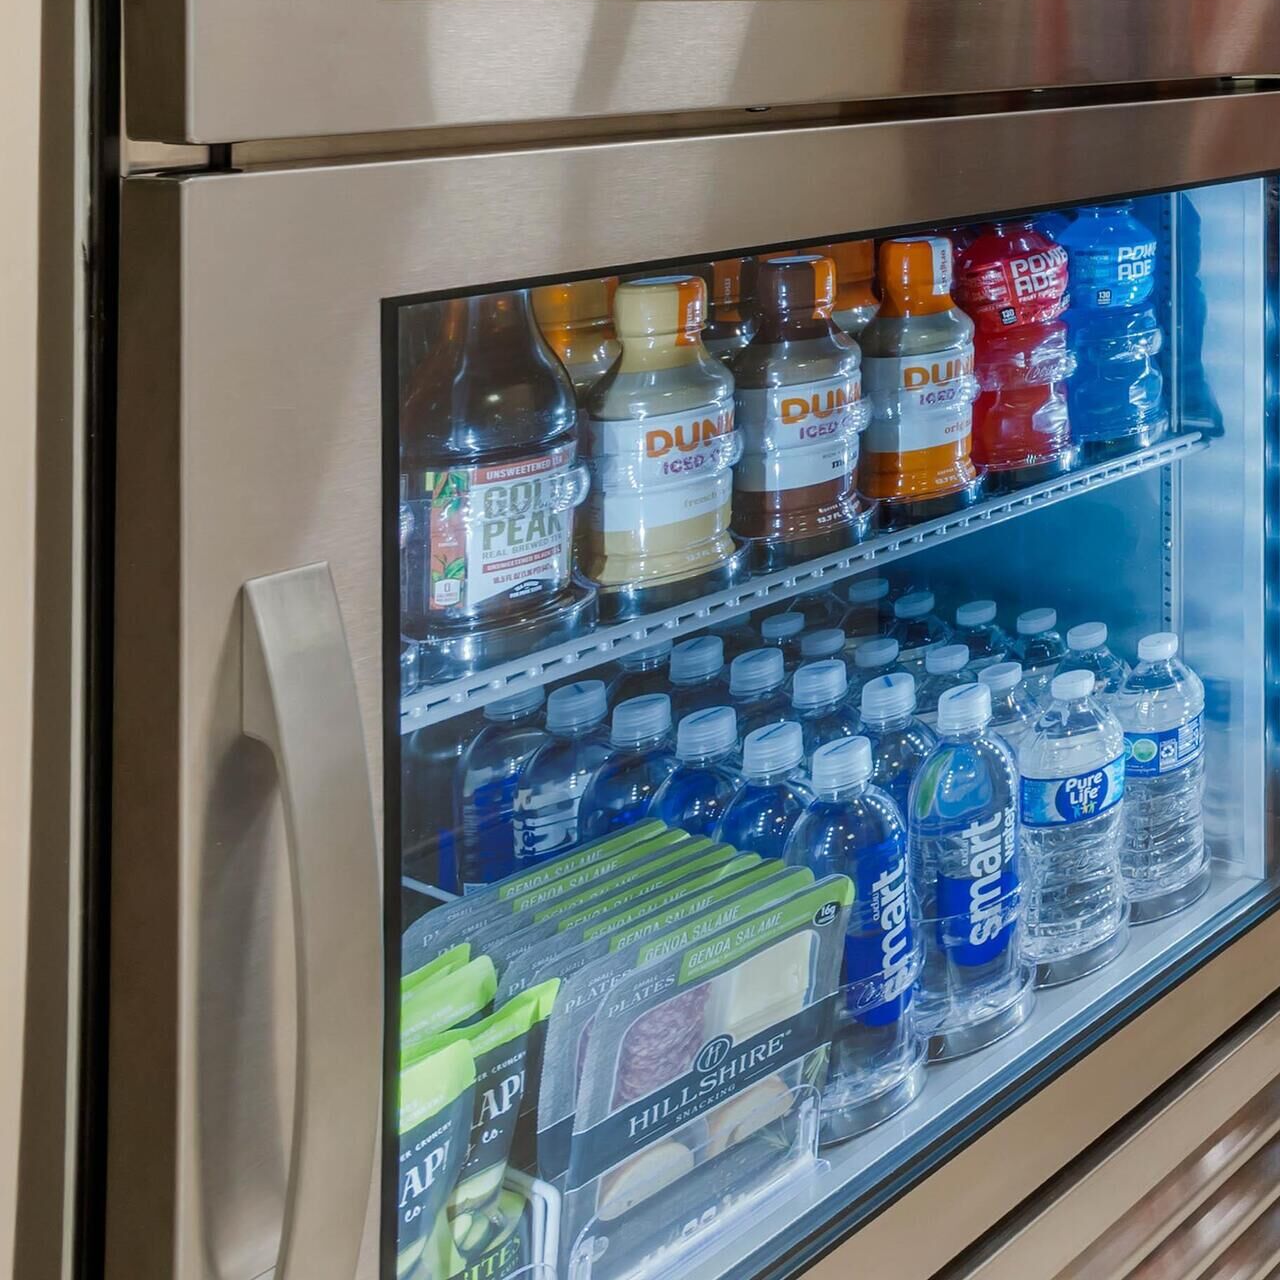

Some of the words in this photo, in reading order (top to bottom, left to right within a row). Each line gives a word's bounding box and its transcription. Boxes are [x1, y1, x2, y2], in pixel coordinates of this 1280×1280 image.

[1010, 245, 1068, 279] POWE
[1117, 240, 1157, 263] POW
[1013, 270, 1058, 297] ADE
[1117, 258, 1152, 281] ADE
[919, 388, 956, 406] ICED
[799, 422, 837, 440] ICED
[485, 458, 551, 481] UNSWEETENED
[663, 455, 705, 475] ICED
[482, 509, 563, 552] PEAK
[482, 549, 509, 561] REAL
[511, 538, 550, 554] BREWED
[1065, 770, 1103, 794] Pure
[1068, 785, 1099, 806] Life
[1002, 805, 1017, 863] water
[968, 811, 1003, 947] smart
[663, 894, 716, 925] SALAME
[820, 903, 838, 918] 16g
[643, 930, 689, 963] GENOA
[691, 905, 741, 938] SALAME
[687, 942, 732, 969] GENOA
[735, 911, 784, 946] SALAME
[879, 856, 909, 1004] smart
[606, 973, 676, 1018] PLATES
[490, 1050, 528, 1075] CRUNCHY
[627, 1031, 785, 1138] HILLSHIRE
[674, 1083, 737, 1123] SNACKING
[415, 1119, 453, 1149] CRUNCHY
